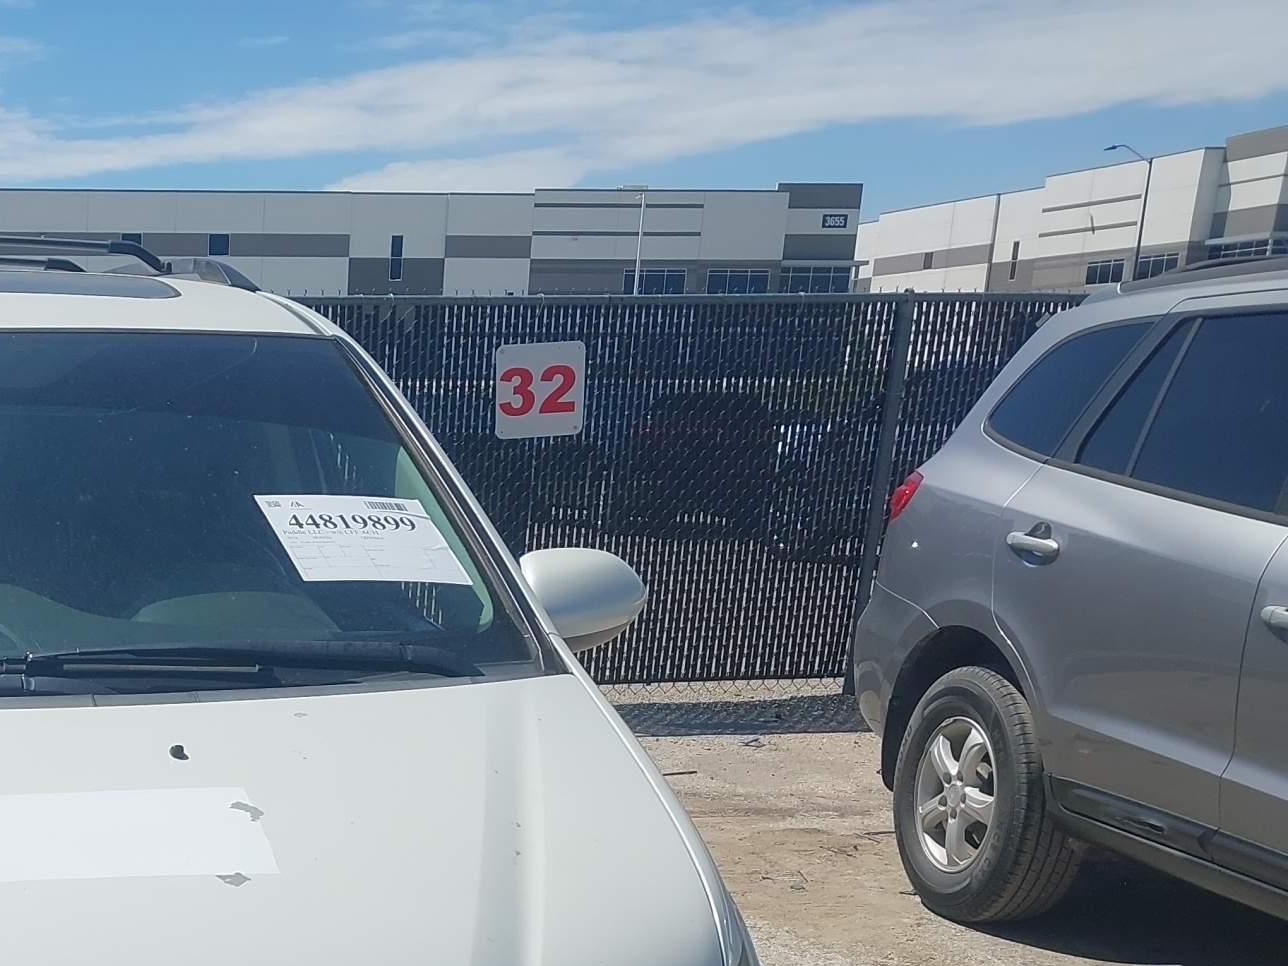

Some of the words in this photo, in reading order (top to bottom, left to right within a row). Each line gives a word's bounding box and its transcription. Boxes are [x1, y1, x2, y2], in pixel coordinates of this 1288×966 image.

[825, 216, 845, 226] 3655
[499, 365, 576, 416] 32
[288, 514, 416, 532] 44819899
